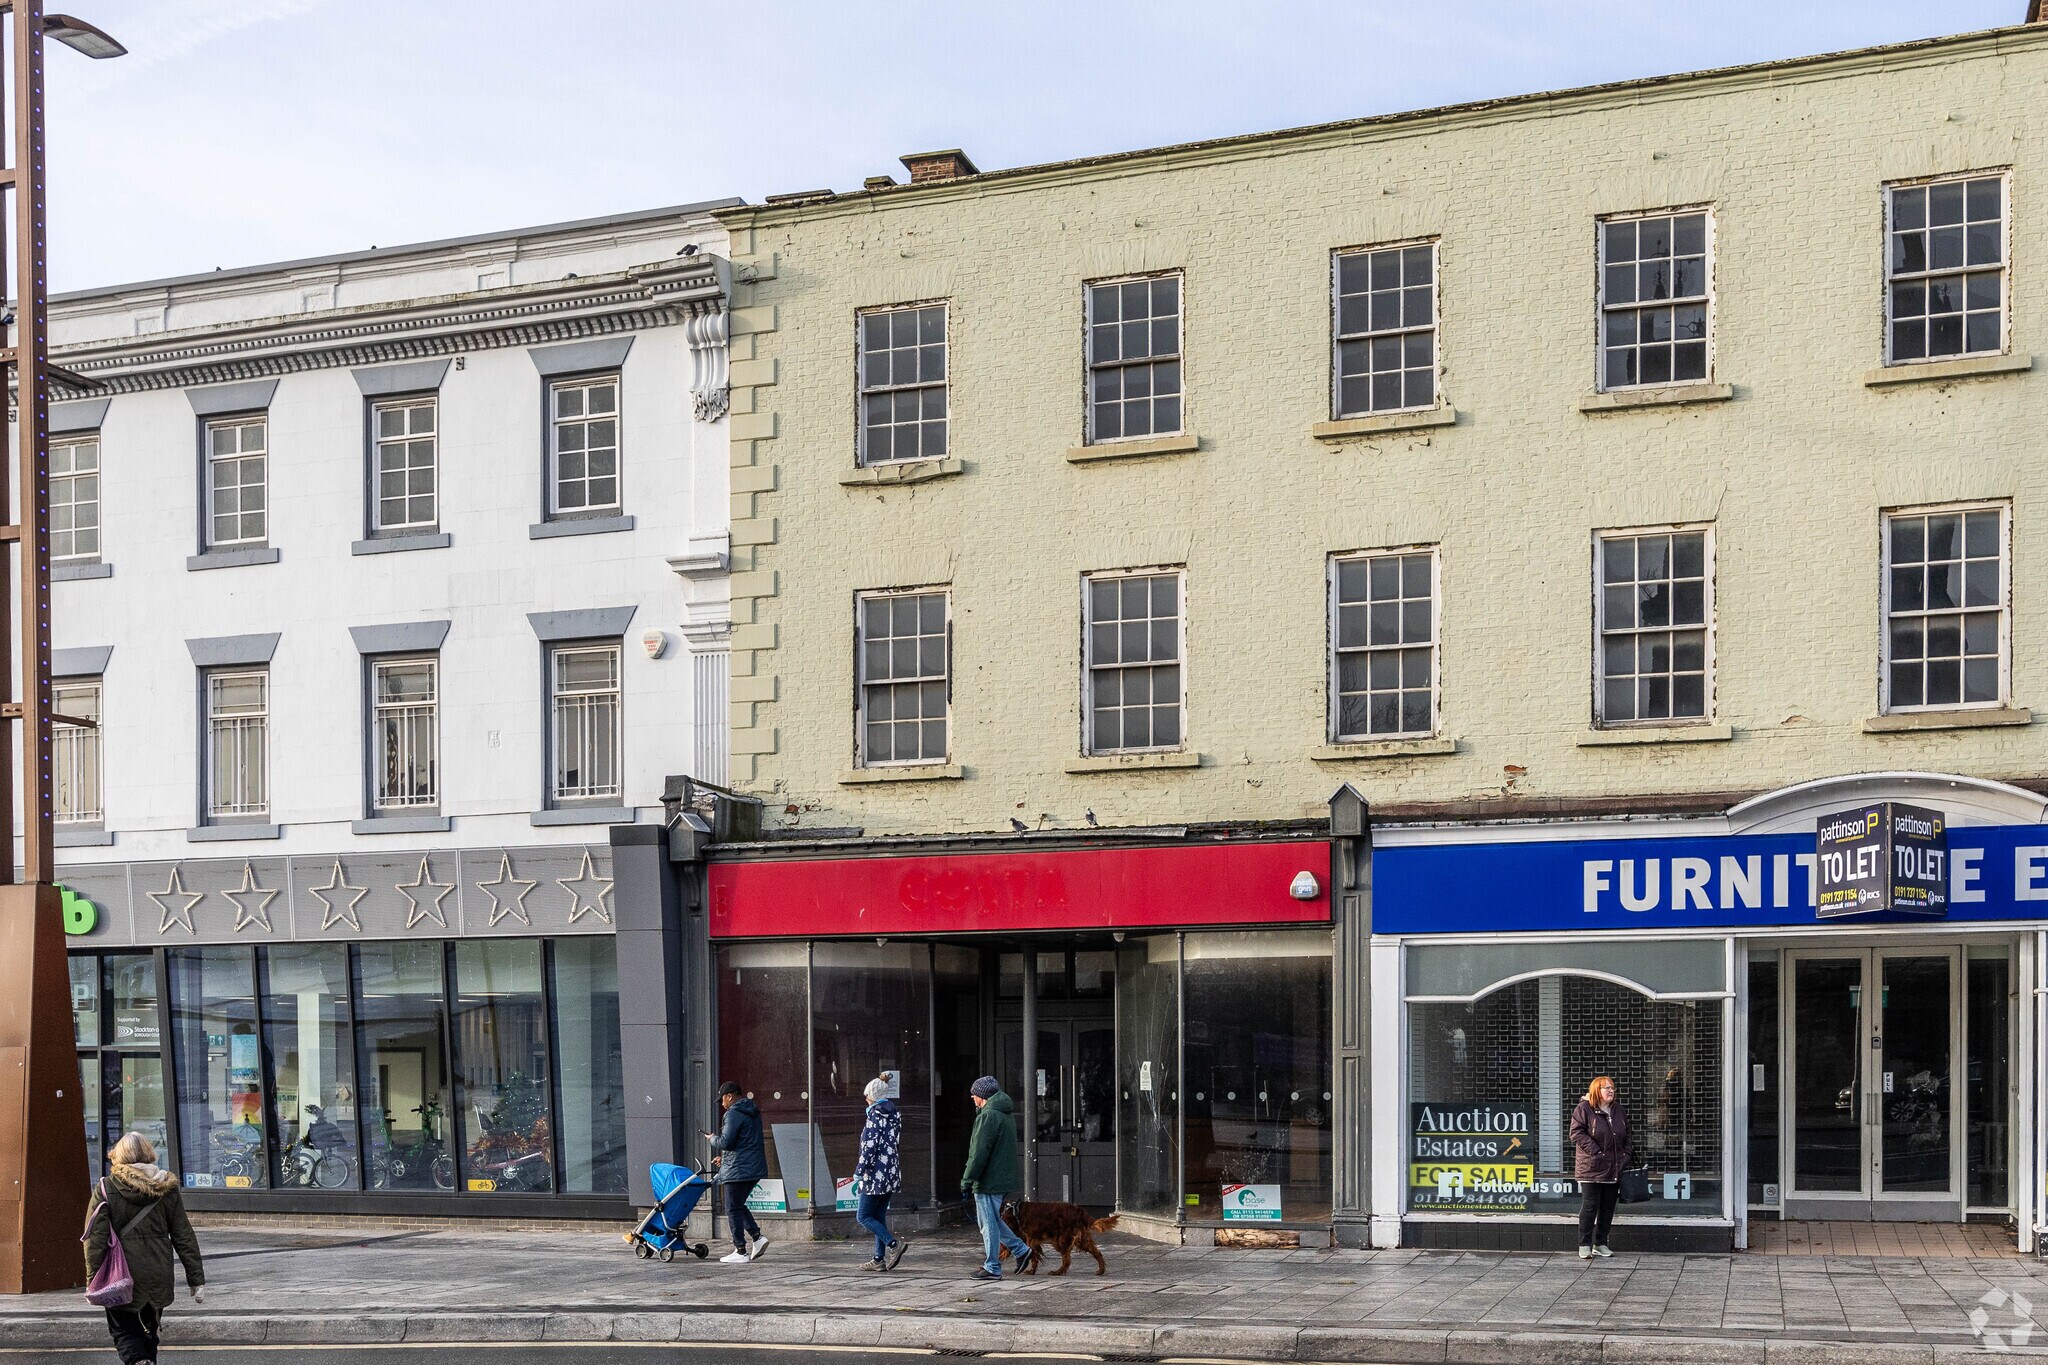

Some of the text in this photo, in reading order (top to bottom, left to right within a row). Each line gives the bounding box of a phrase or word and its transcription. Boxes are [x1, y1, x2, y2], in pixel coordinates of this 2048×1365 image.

[1820, 819, 1865, 846] pattinson
[1895, 814, 1932, 836] pattinson
[1821, 844, 1880, 885] TO LET
[1895, 845, 1944, 881] TO LET
[1583, 847, 1986, 912] FURNITE
[1820, 888, 1857, 904] 0191 737 1154
[1894, 885, 1927, 899] 0191 737 1154
[1416, 1106, 1528, 1132] Auction
[1416, 1137, 1498, 1157] Estates
[1469, 1167, 1529, 1185] SALE
[753, 1189, 771, 1197] base
[1474, 1178, 1526, 1193] Follow
[1530, 1182, 1550, 1194] us
[1552, 1182, 1573, 1194] on
[1244, 1195, 1265, 1204] base
[1456, 1194, 1494, 1204] 7844
[1498, 1194, 1528, 1204] 600
